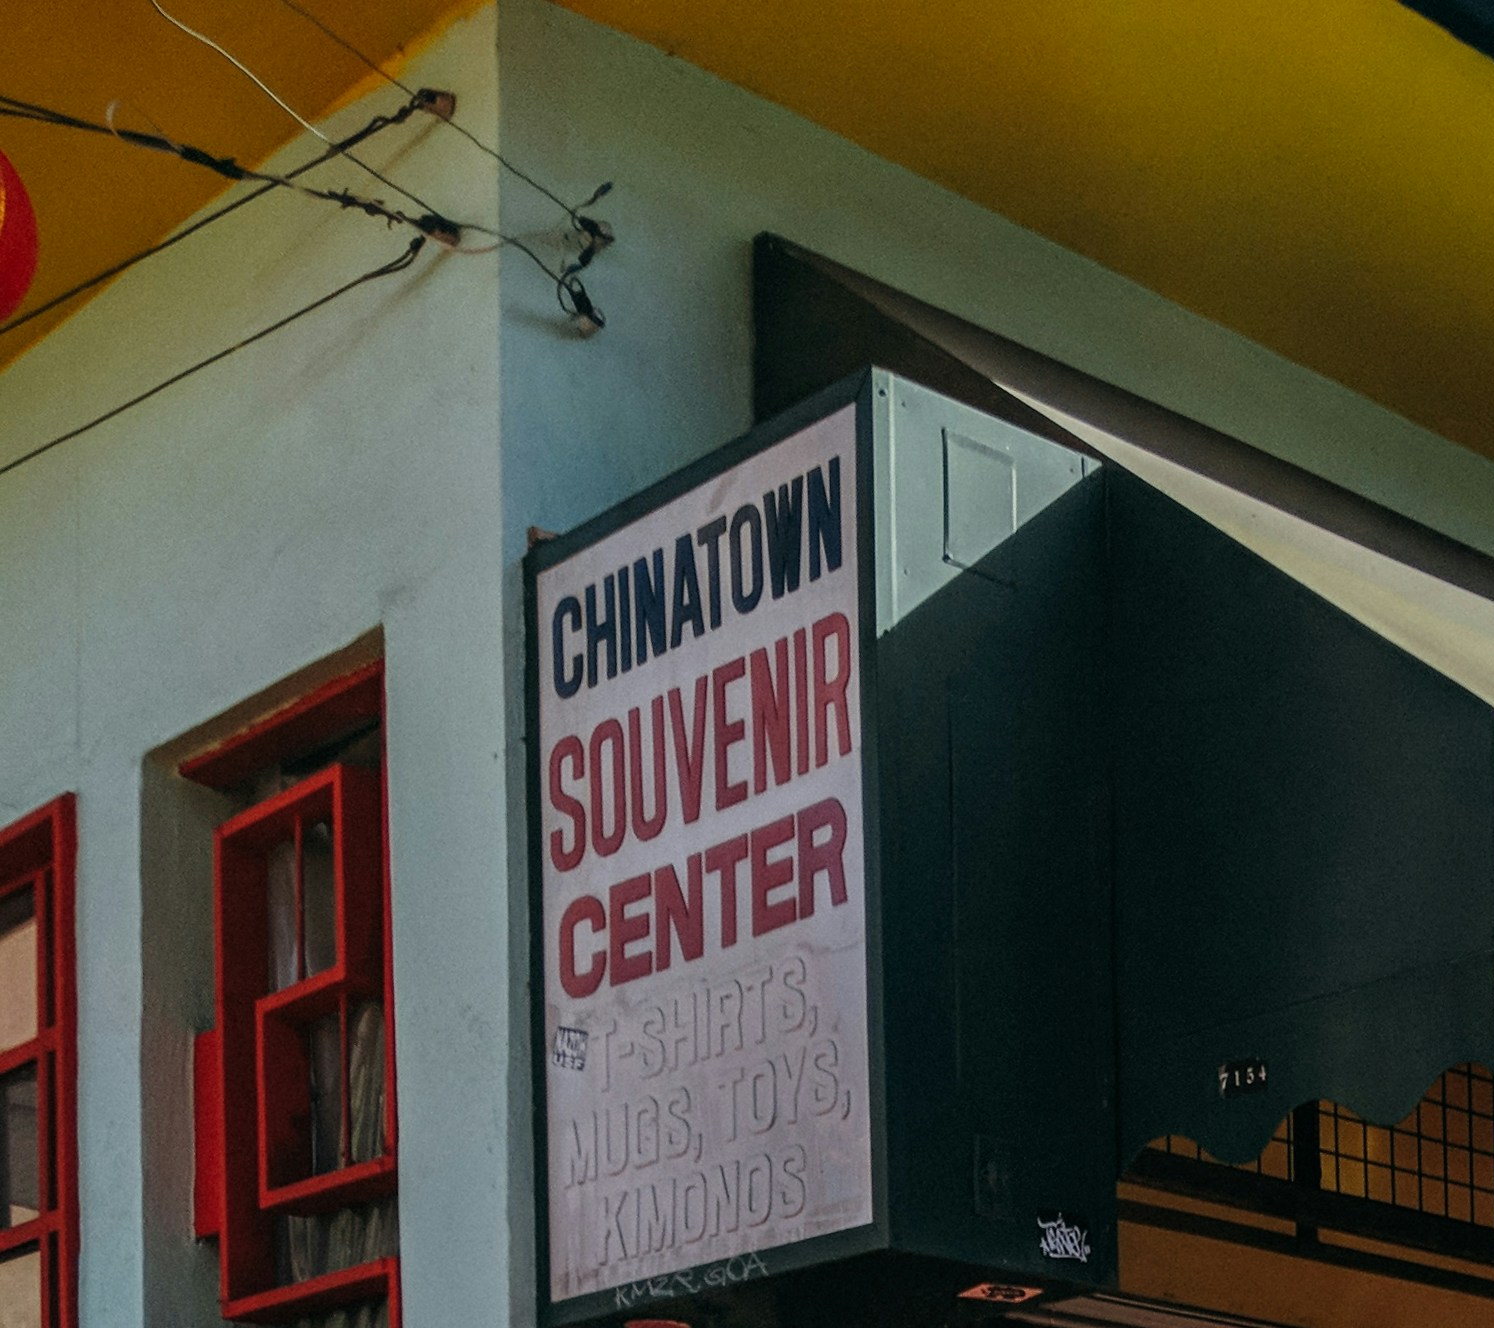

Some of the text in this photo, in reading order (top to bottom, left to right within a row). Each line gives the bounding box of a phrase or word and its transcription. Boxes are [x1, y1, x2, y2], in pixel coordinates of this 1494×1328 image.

[552, 455, 843, 699] CHINATOWN
[548, 611, 852, 873] SOUVENIR
[558, 796, 848, 999] CENTER
[590, 955, 819, 1093] T-SHIRTS,
[564, 1038, 851, 1190] MUGS, TOYS,
[598, 1143, 806, 1266] KIMONOS
